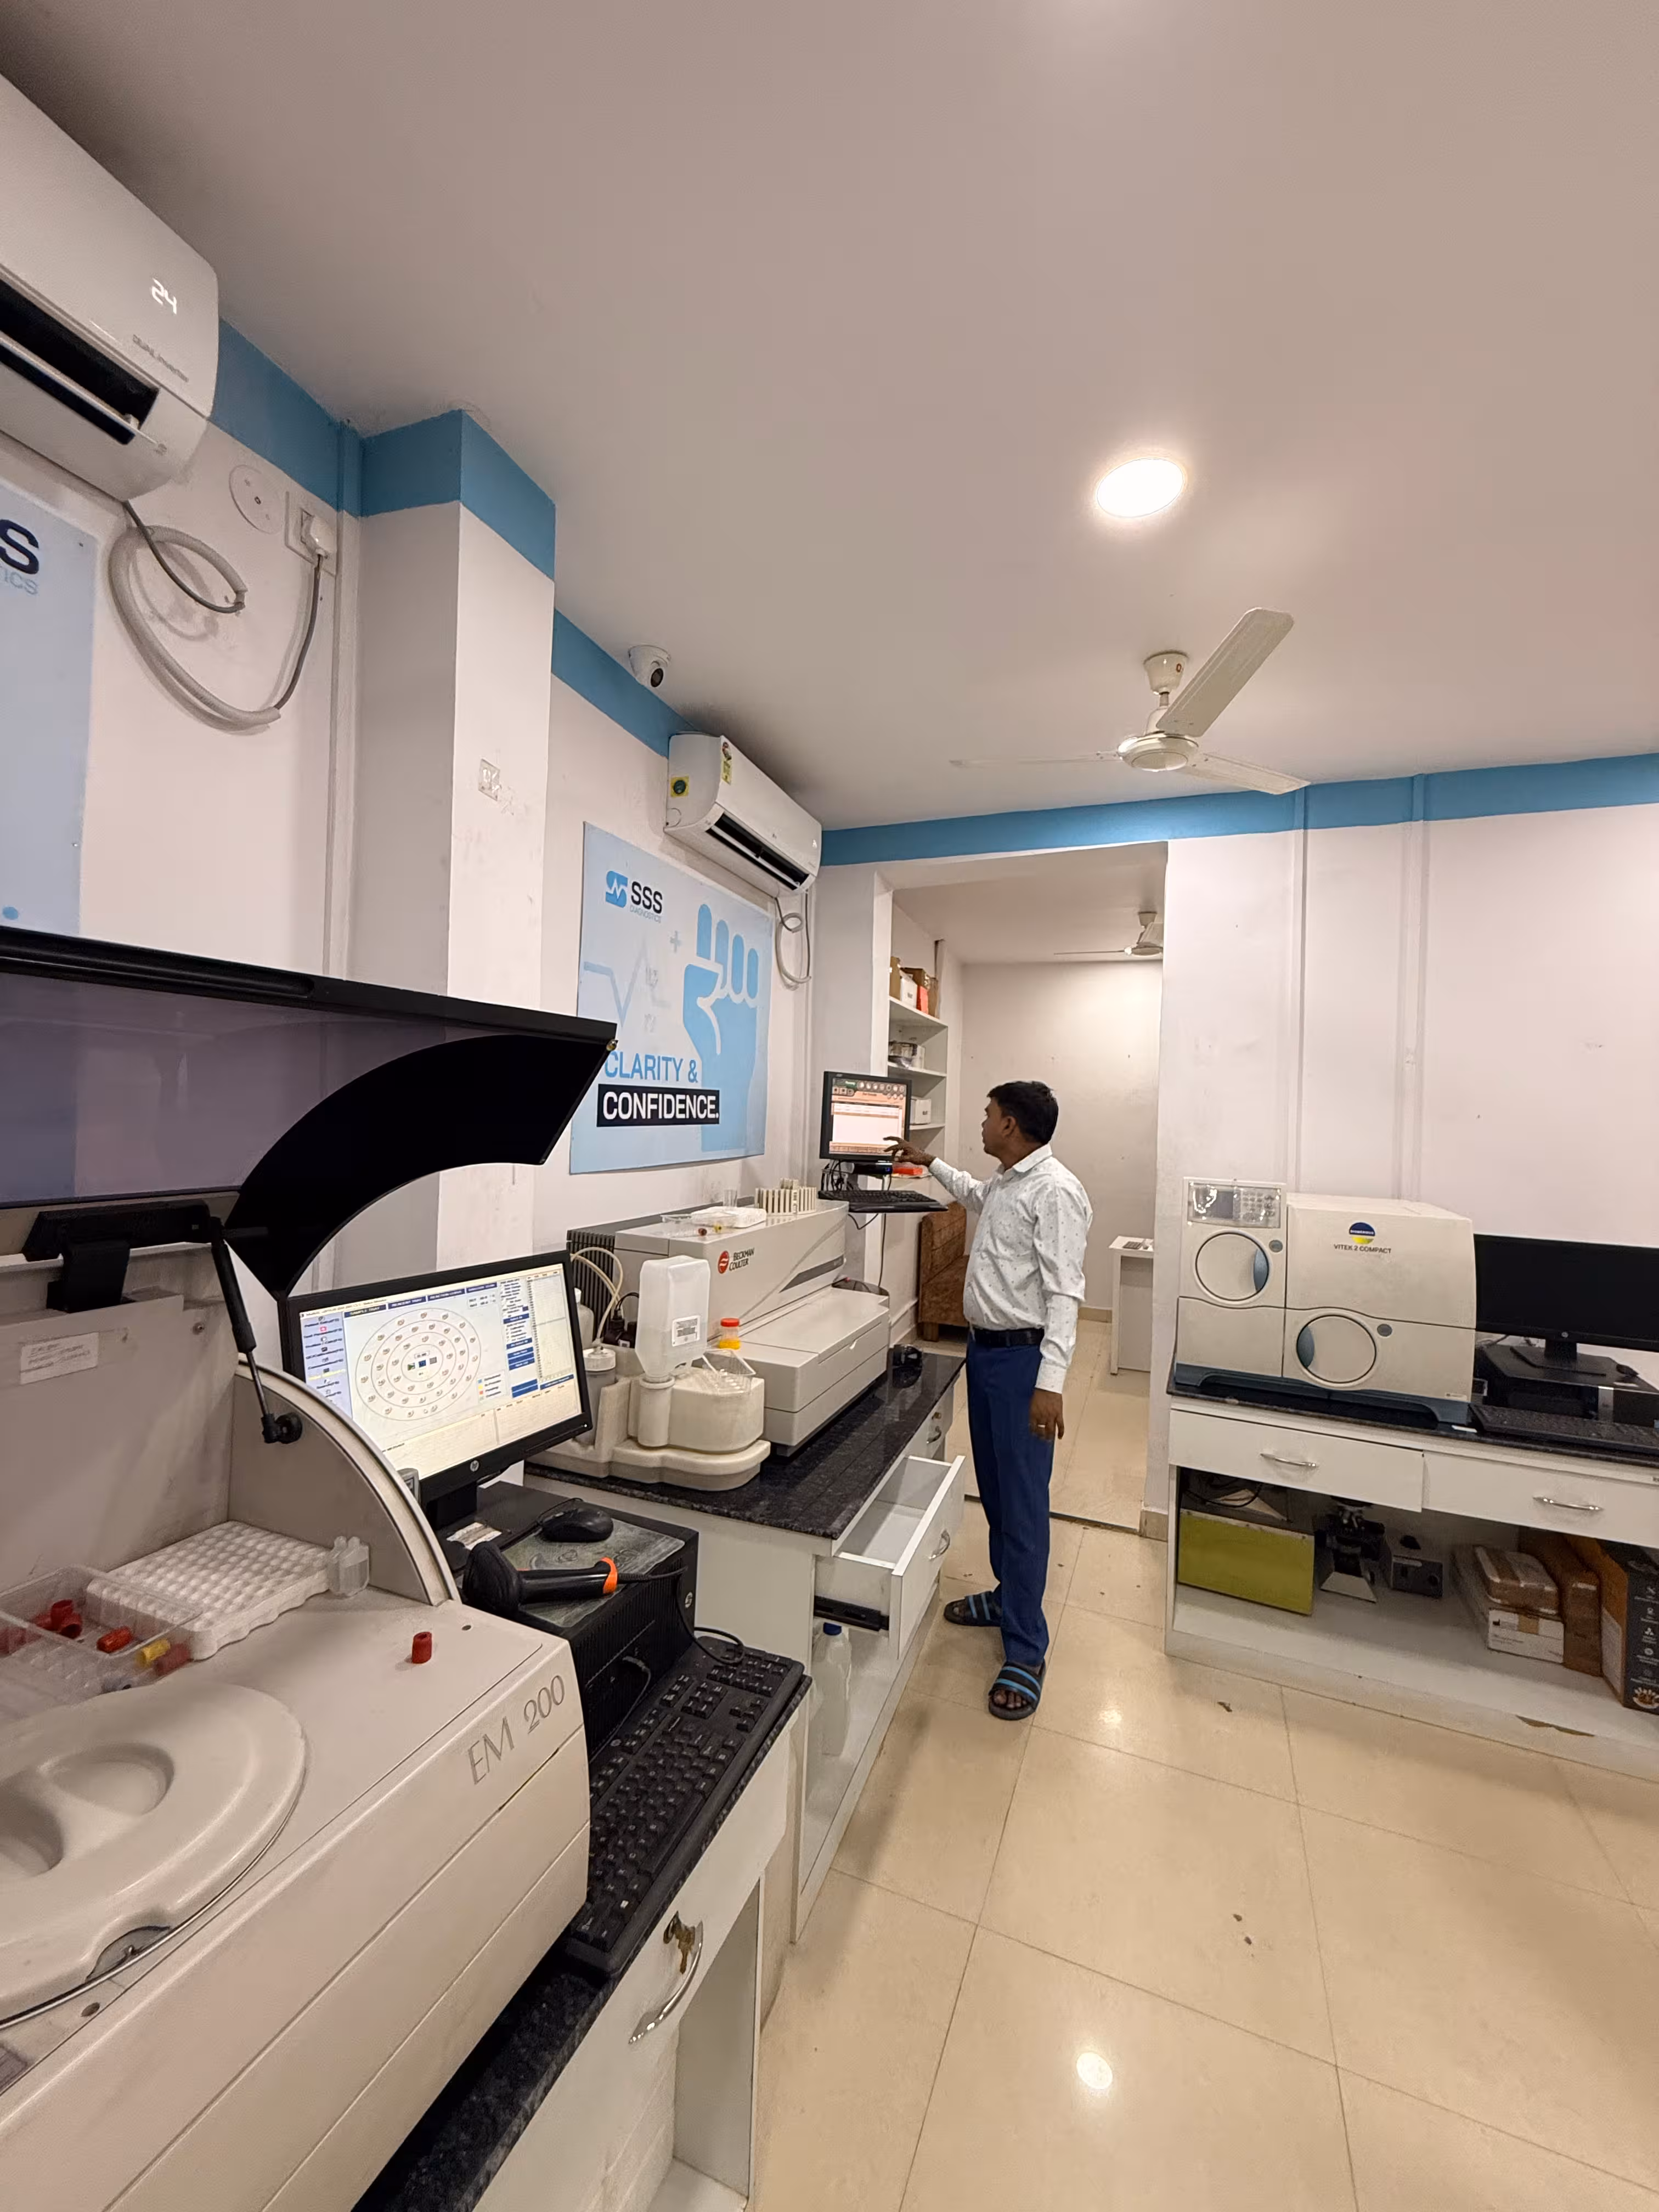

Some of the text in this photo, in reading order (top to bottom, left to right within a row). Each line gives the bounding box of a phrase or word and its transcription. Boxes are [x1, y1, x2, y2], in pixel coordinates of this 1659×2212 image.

[151, 278, 177, 314] 24
[631, 881, 663, 914] SSS
[605, 1051, 698, 1083] CLARITY &
[603, 1091, 719, 1120] CONFIDENCE.
[729, 1258, 749, 1271] COULTER
[733, 1248, 755, 1262] BECKMAN
[467, 1675, 565, 1785] EM 200
